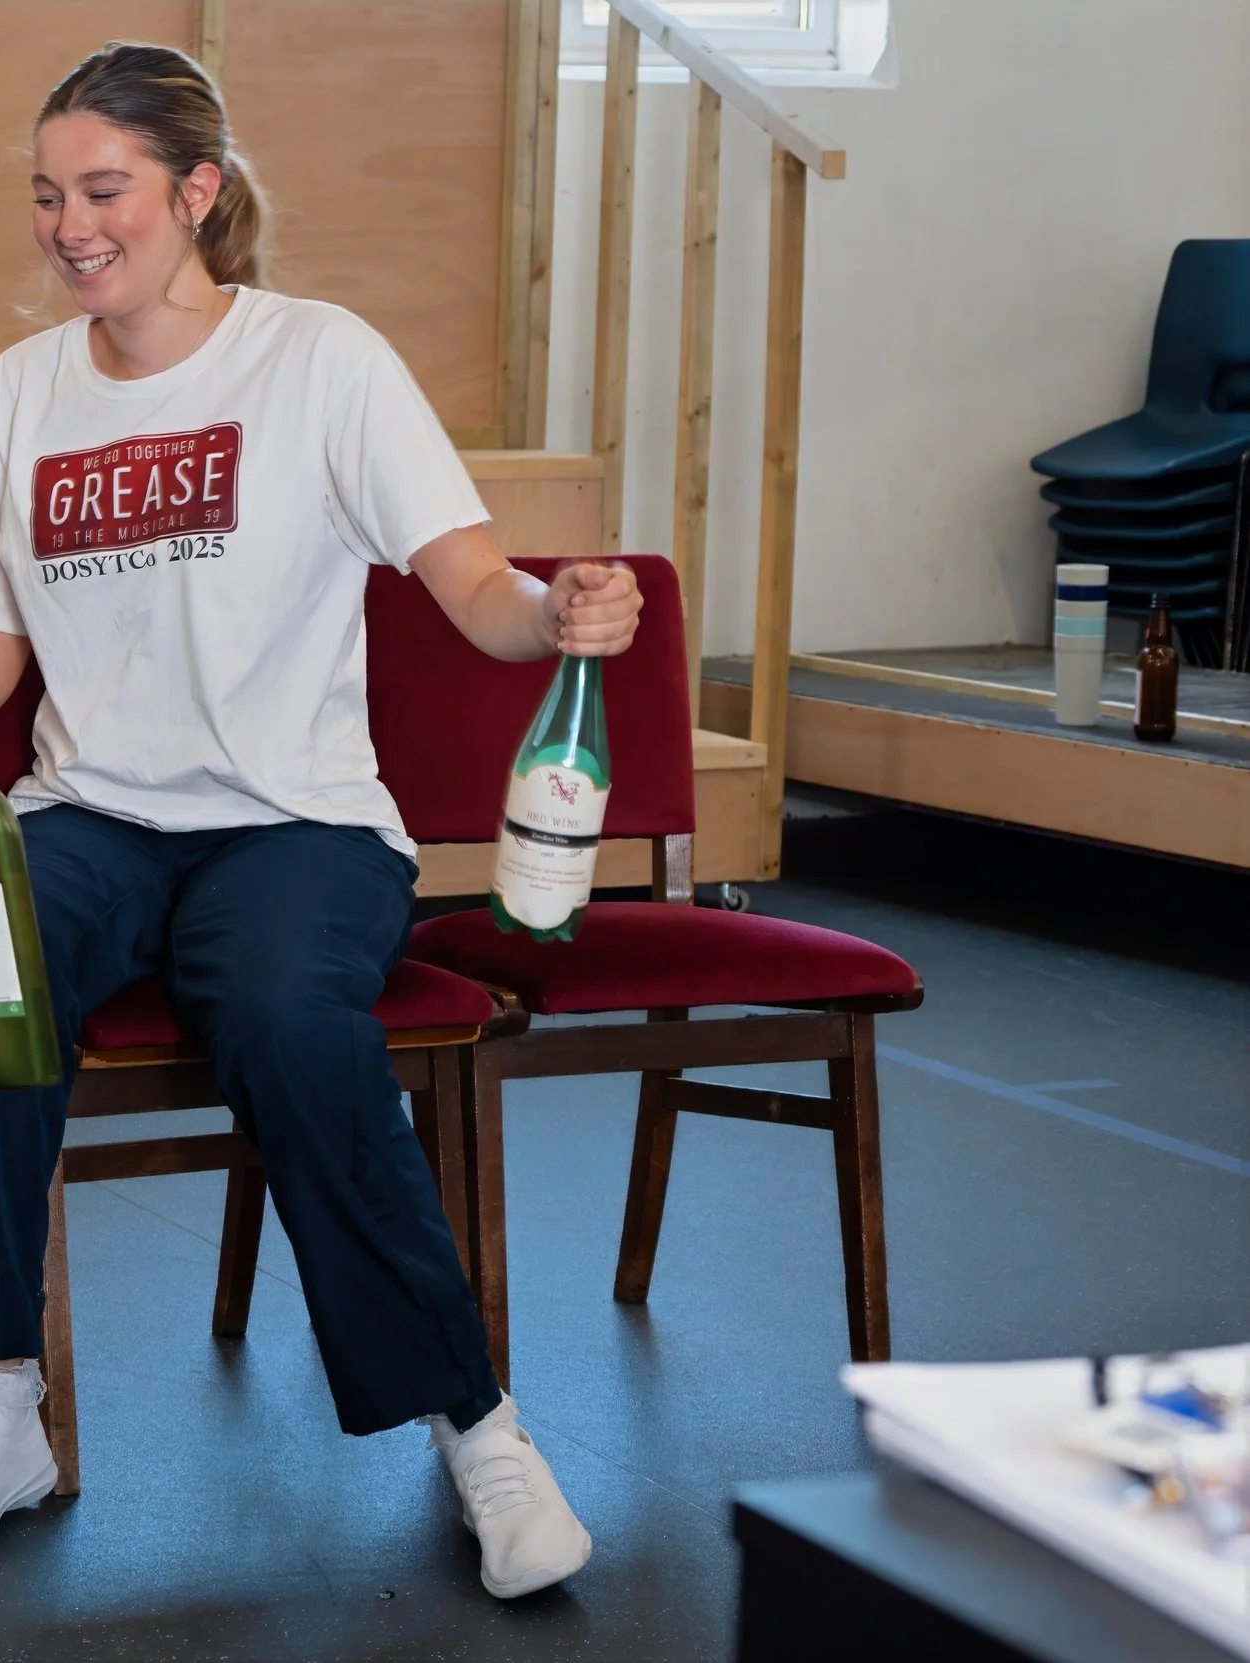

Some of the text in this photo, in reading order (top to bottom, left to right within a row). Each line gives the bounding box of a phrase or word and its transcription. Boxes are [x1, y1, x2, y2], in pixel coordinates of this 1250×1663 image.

[83, 440, 195, 471] WE GO TOGETHER
[49, 452, 225, 526] GREASE
[52, 509, 221, 549] 19 THE MUSICAL 59
[41, 535, 225, 585] DOSYTCo 2025
[553, 816, 581, 829] WINE
